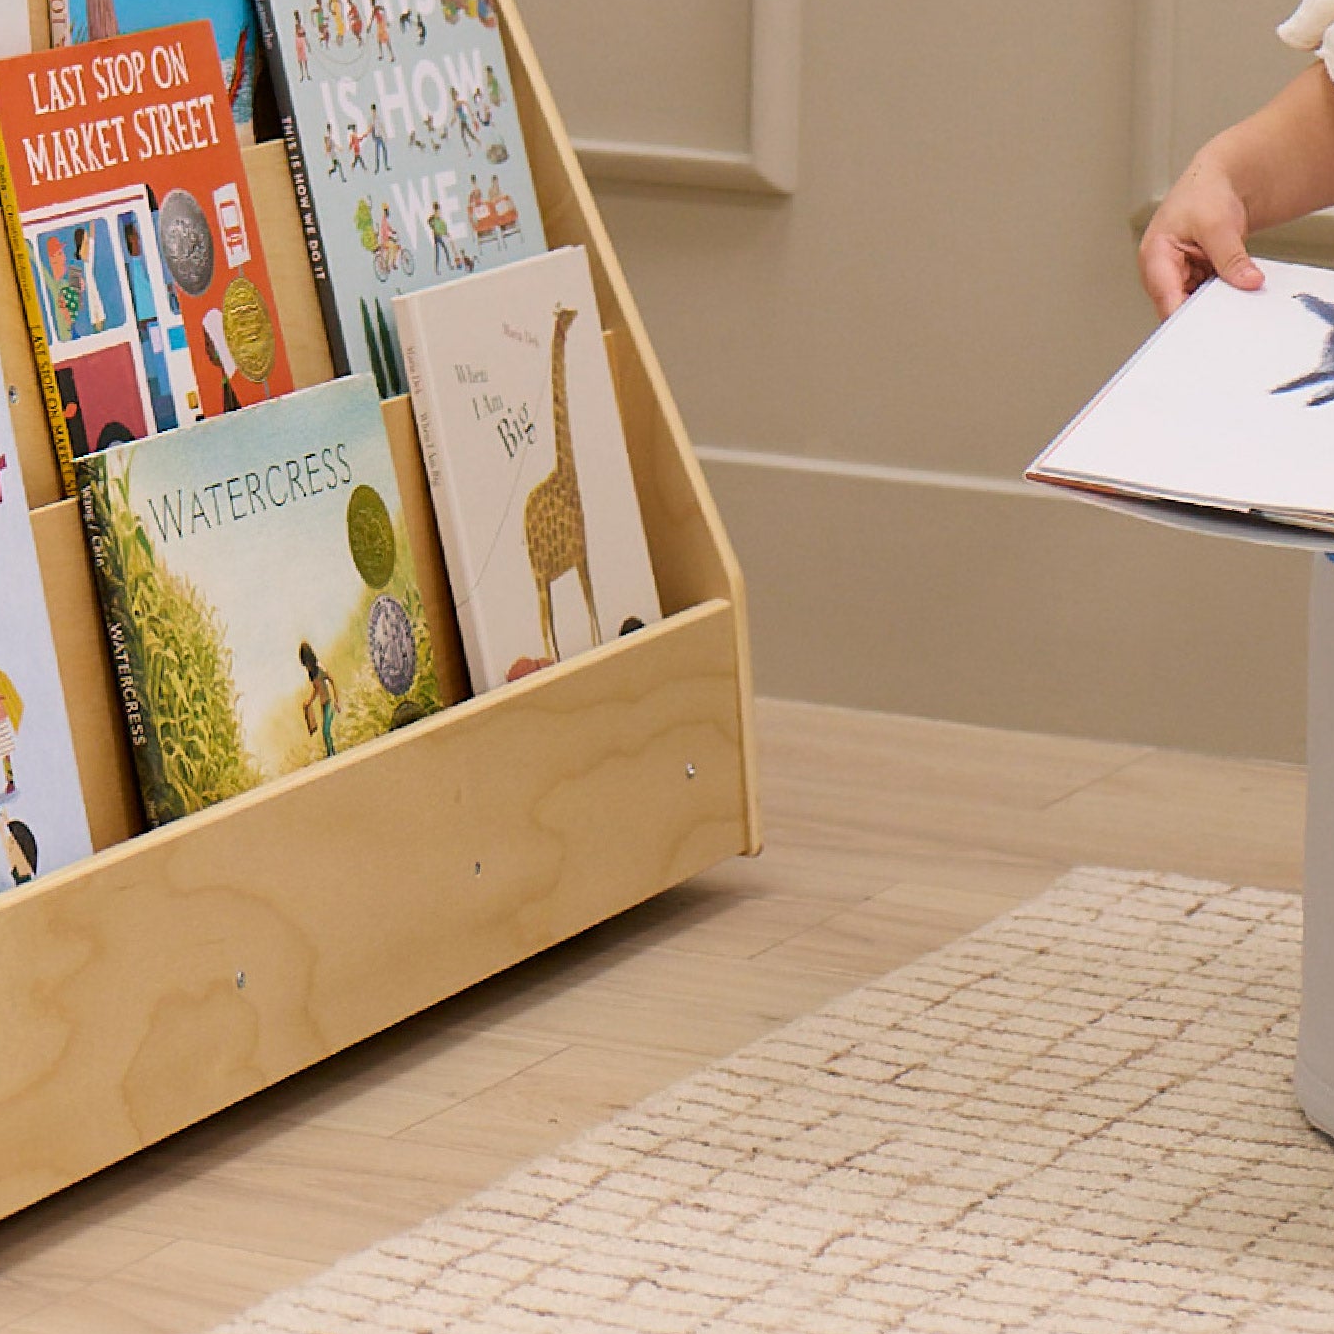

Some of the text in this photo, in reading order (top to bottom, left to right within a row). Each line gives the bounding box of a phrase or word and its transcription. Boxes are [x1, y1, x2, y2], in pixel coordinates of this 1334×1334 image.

[28, 42, 190, 116] LAST STOP ON
[320, 50, 485, 151] IS HOW
[22, 94, 220, 186] MARKET STREET
[280, 115, 327, 281] THIS IS HOW WE DO IT
[391, 170, 468, 251] WE
[30, 325, 46, 356] LAST
[39, 361, 56, 394] STOP
[454, 364, 489, 384] When
[46, 397, 59, 418] ON
[472, 394, 504, 420] I Am
[497, 402, 538, 458] Big
[148, 443, 354, 543] WATERCRESS
[107, 622, 149, 748] WATERCRESS
